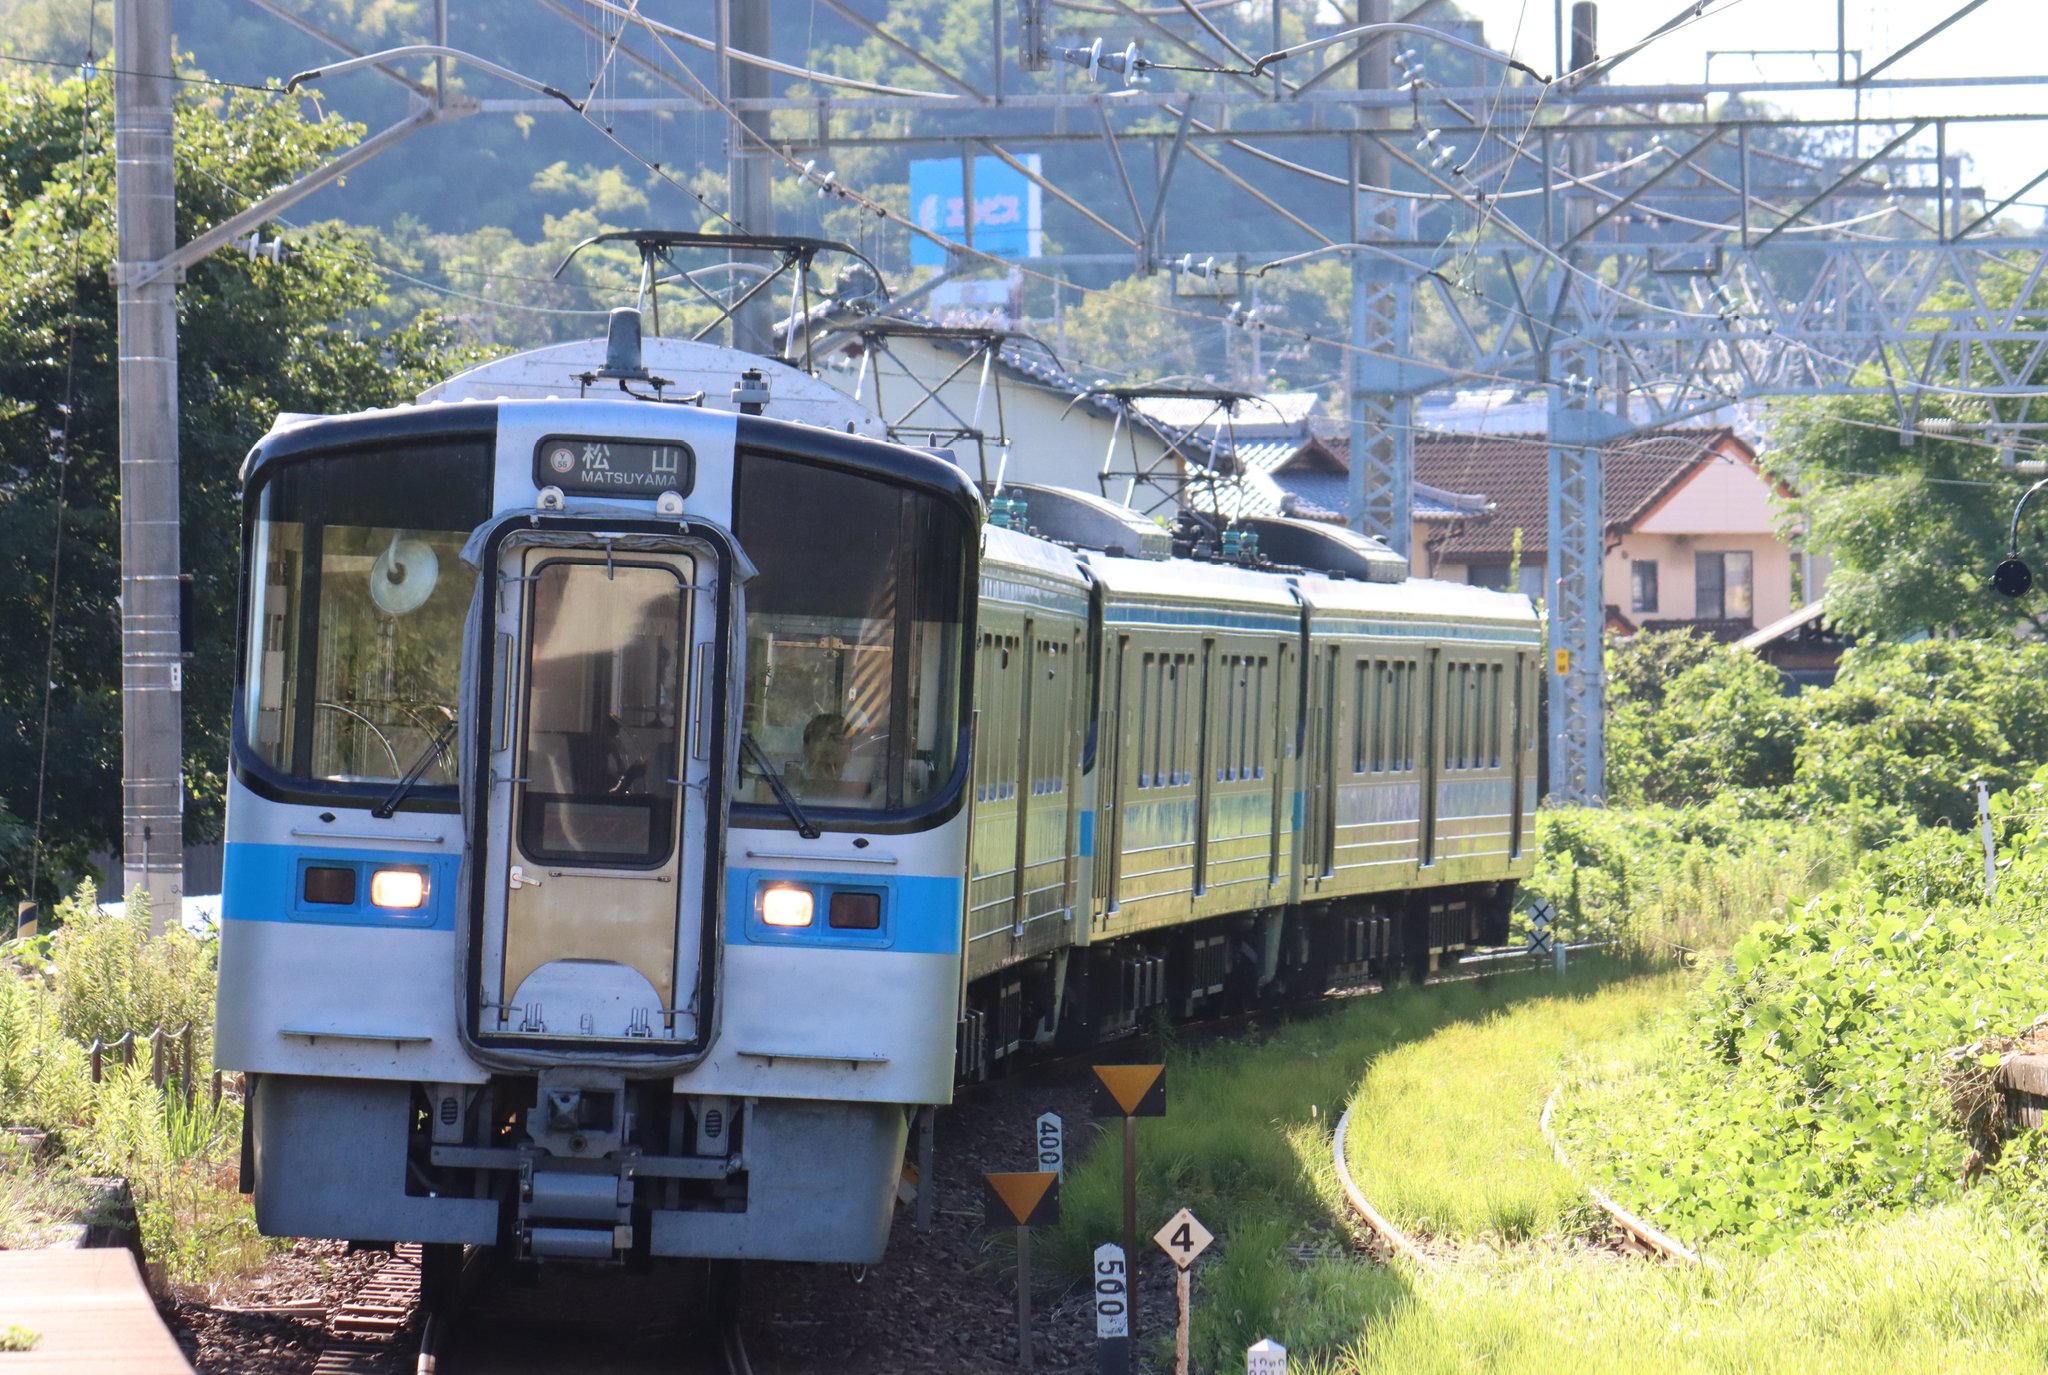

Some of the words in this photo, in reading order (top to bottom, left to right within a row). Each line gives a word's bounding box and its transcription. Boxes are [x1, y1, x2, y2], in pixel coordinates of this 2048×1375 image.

[557, 460, 568, 468] 55
[559, 452, 566, 460] Y
[582, 443, 678, 474] 松山
[581, 470, 678, 487] MATSUYAMA
[1039, 1120, 1060, 1165] 400
[1170, 1223, 1195, 1253] 4
[1096, 1259, 1126, 1316] 500
